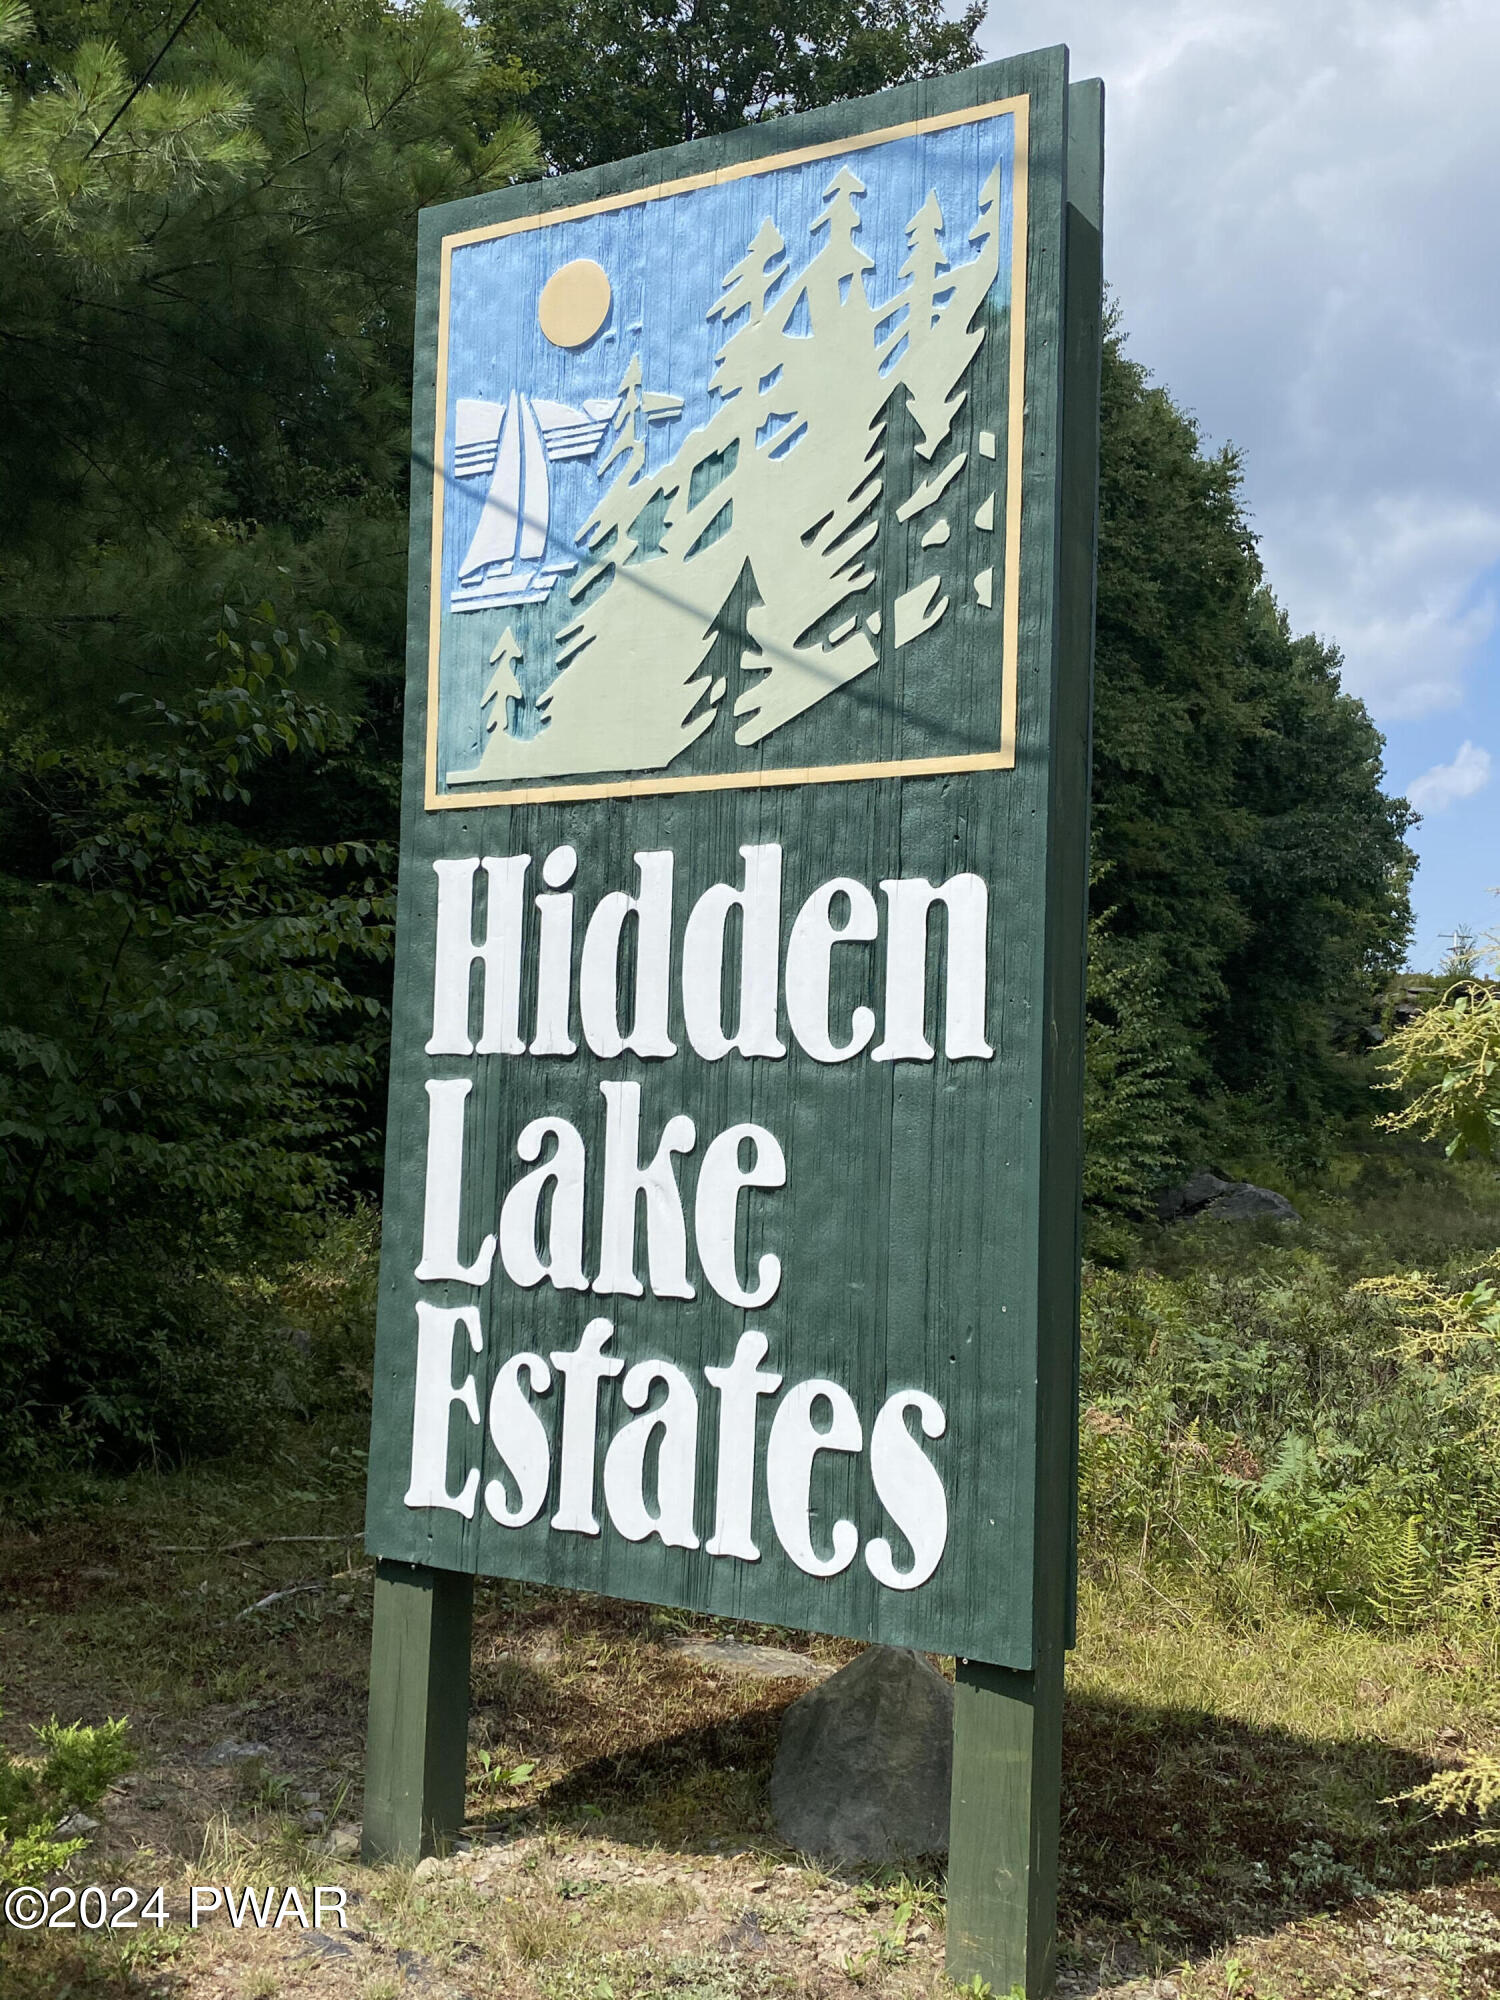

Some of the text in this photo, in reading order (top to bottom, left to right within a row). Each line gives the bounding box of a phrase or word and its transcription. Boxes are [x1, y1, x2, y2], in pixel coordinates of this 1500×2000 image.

[424, 841, 995, 1063] Hidden
[414, 1078, 788, 1309] Lake
[403, 1299, 949, 1590] Estates
